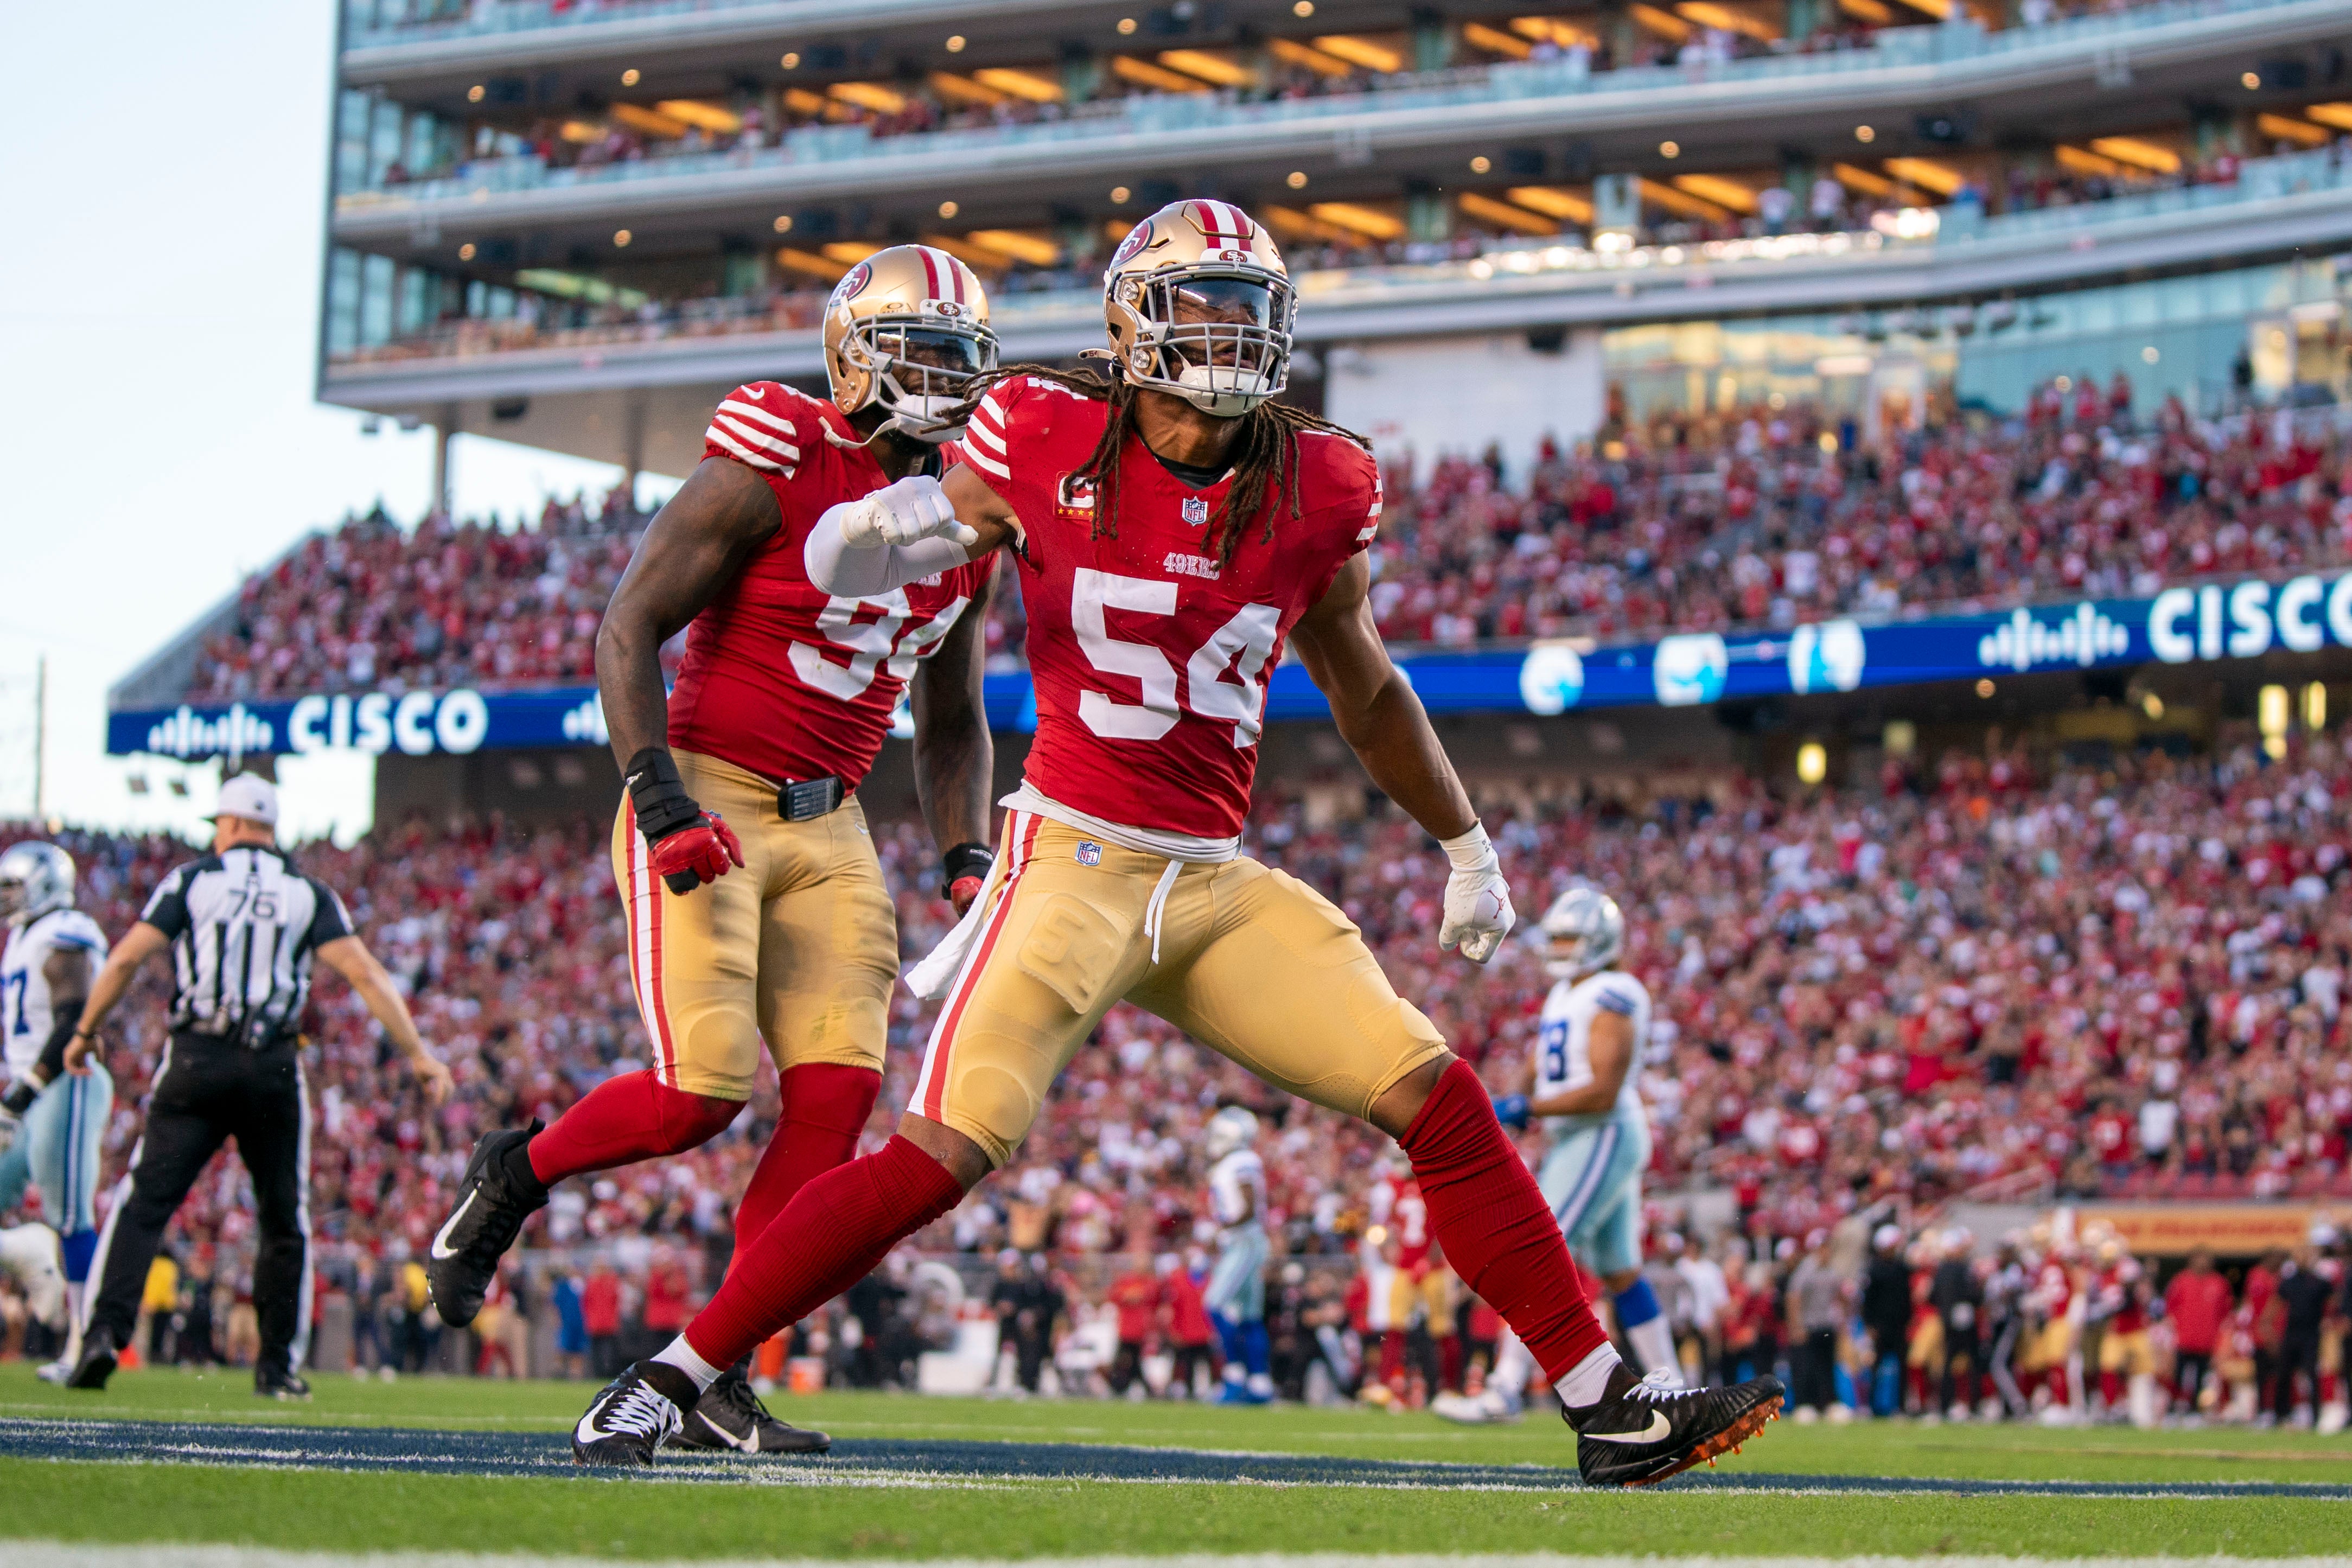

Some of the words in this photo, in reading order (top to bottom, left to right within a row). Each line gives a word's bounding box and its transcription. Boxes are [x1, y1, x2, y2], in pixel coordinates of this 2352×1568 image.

[1186, 508, 1203, 521] NFL
[1163, 552, 1220, 581] 49ERS
[1071, 566, 1282, 749] 54
[287, 688, 489, 756] CISCO
[1079, 850, 1095, 862] NFL
[228, 889, 279, 919] 76
